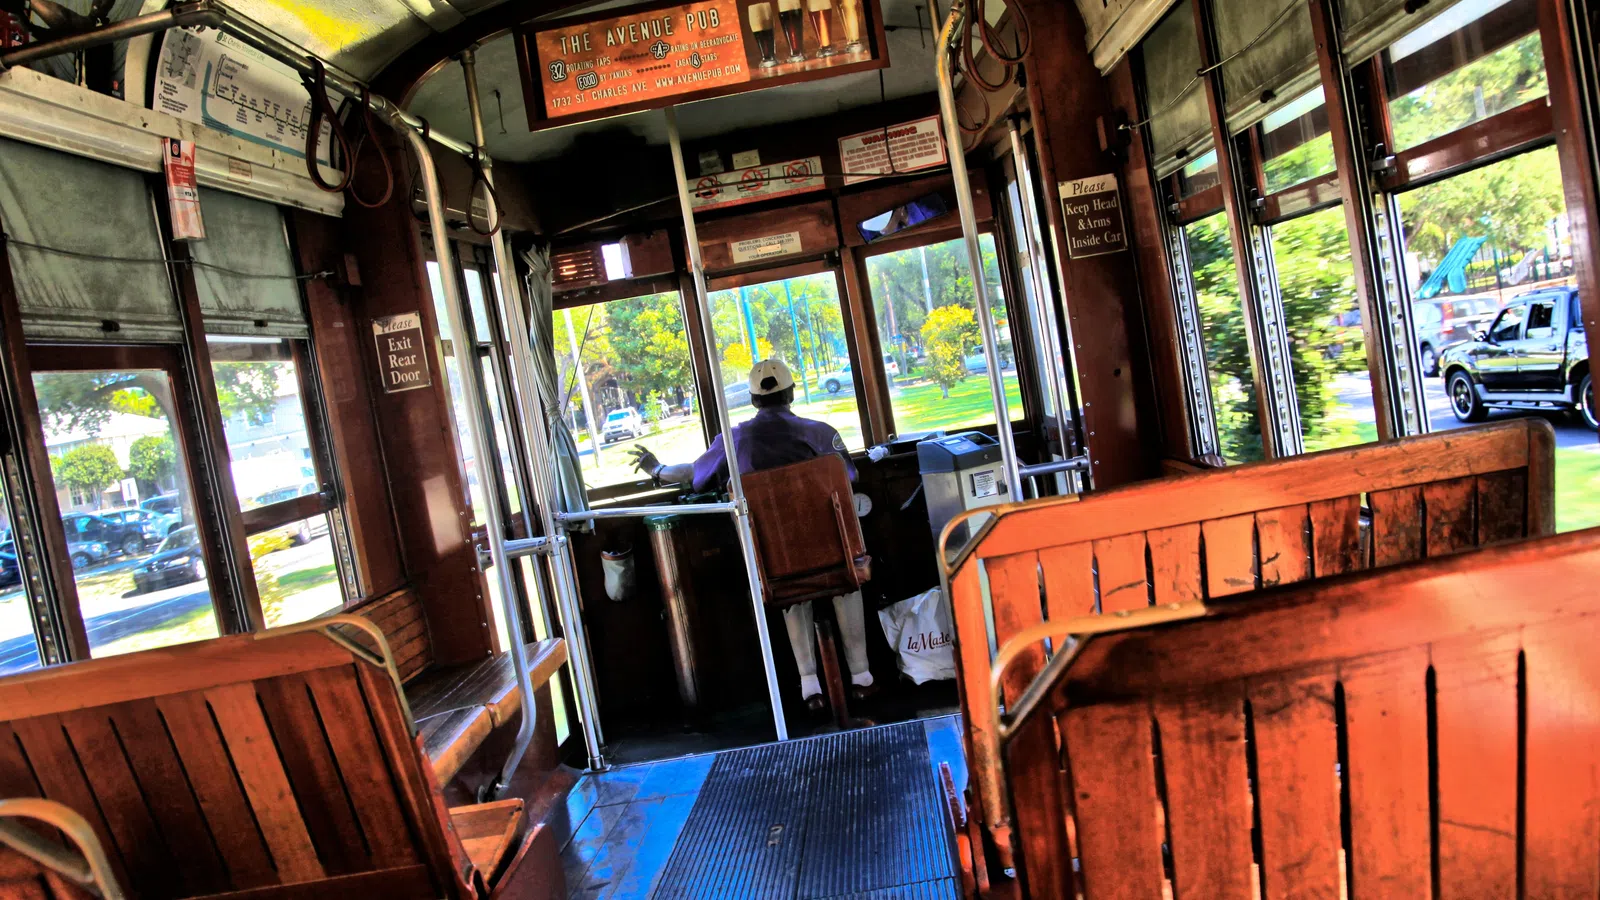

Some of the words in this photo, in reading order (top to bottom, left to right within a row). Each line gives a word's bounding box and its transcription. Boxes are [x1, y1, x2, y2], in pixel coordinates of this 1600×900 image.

[560, 32, 592, 55] THE
[607, 17, 673, 47] AVENUE
[686, 8, 720, 32] PUB
[670, 43, 689, 53] RATING
[690, 42, 698, 51] ON
[700, 33, 739, 49] BEERADVOCATE
[550, 61, 566, 81] 32
[566, 60, 594, 73] ROTATING
[596, 56, 612, 68] TAPS
[675, 57, 692, 68] ZAGAT
[701, 53, 718, 63] STARS
[552, 96, 572, 108] 1732
[575, 93, 589, 104] ST.
[591, 84, 628, 101] CHARLES
[632, 82, 647, 93] AVE
[655, 64, 741, 88] WWW.AVENUEPUB.COM
[578, 73, 597, 89] FOOD
[600, 74, 607, 82] BY
[1072, 181, 1106, 195] Please
[1065, 202, 1090, 216] Keep
[1093, 196, 1117, 211] Head
[1072, 234, 1101, 249] Inside
[1104, 231, 1121, 243] Car
[381, 319, 413, 333] Please
[387, 336, 412, 352] Exit
[388, 354, 417, 369] Rear
[390, 370, 421, 385] Door
